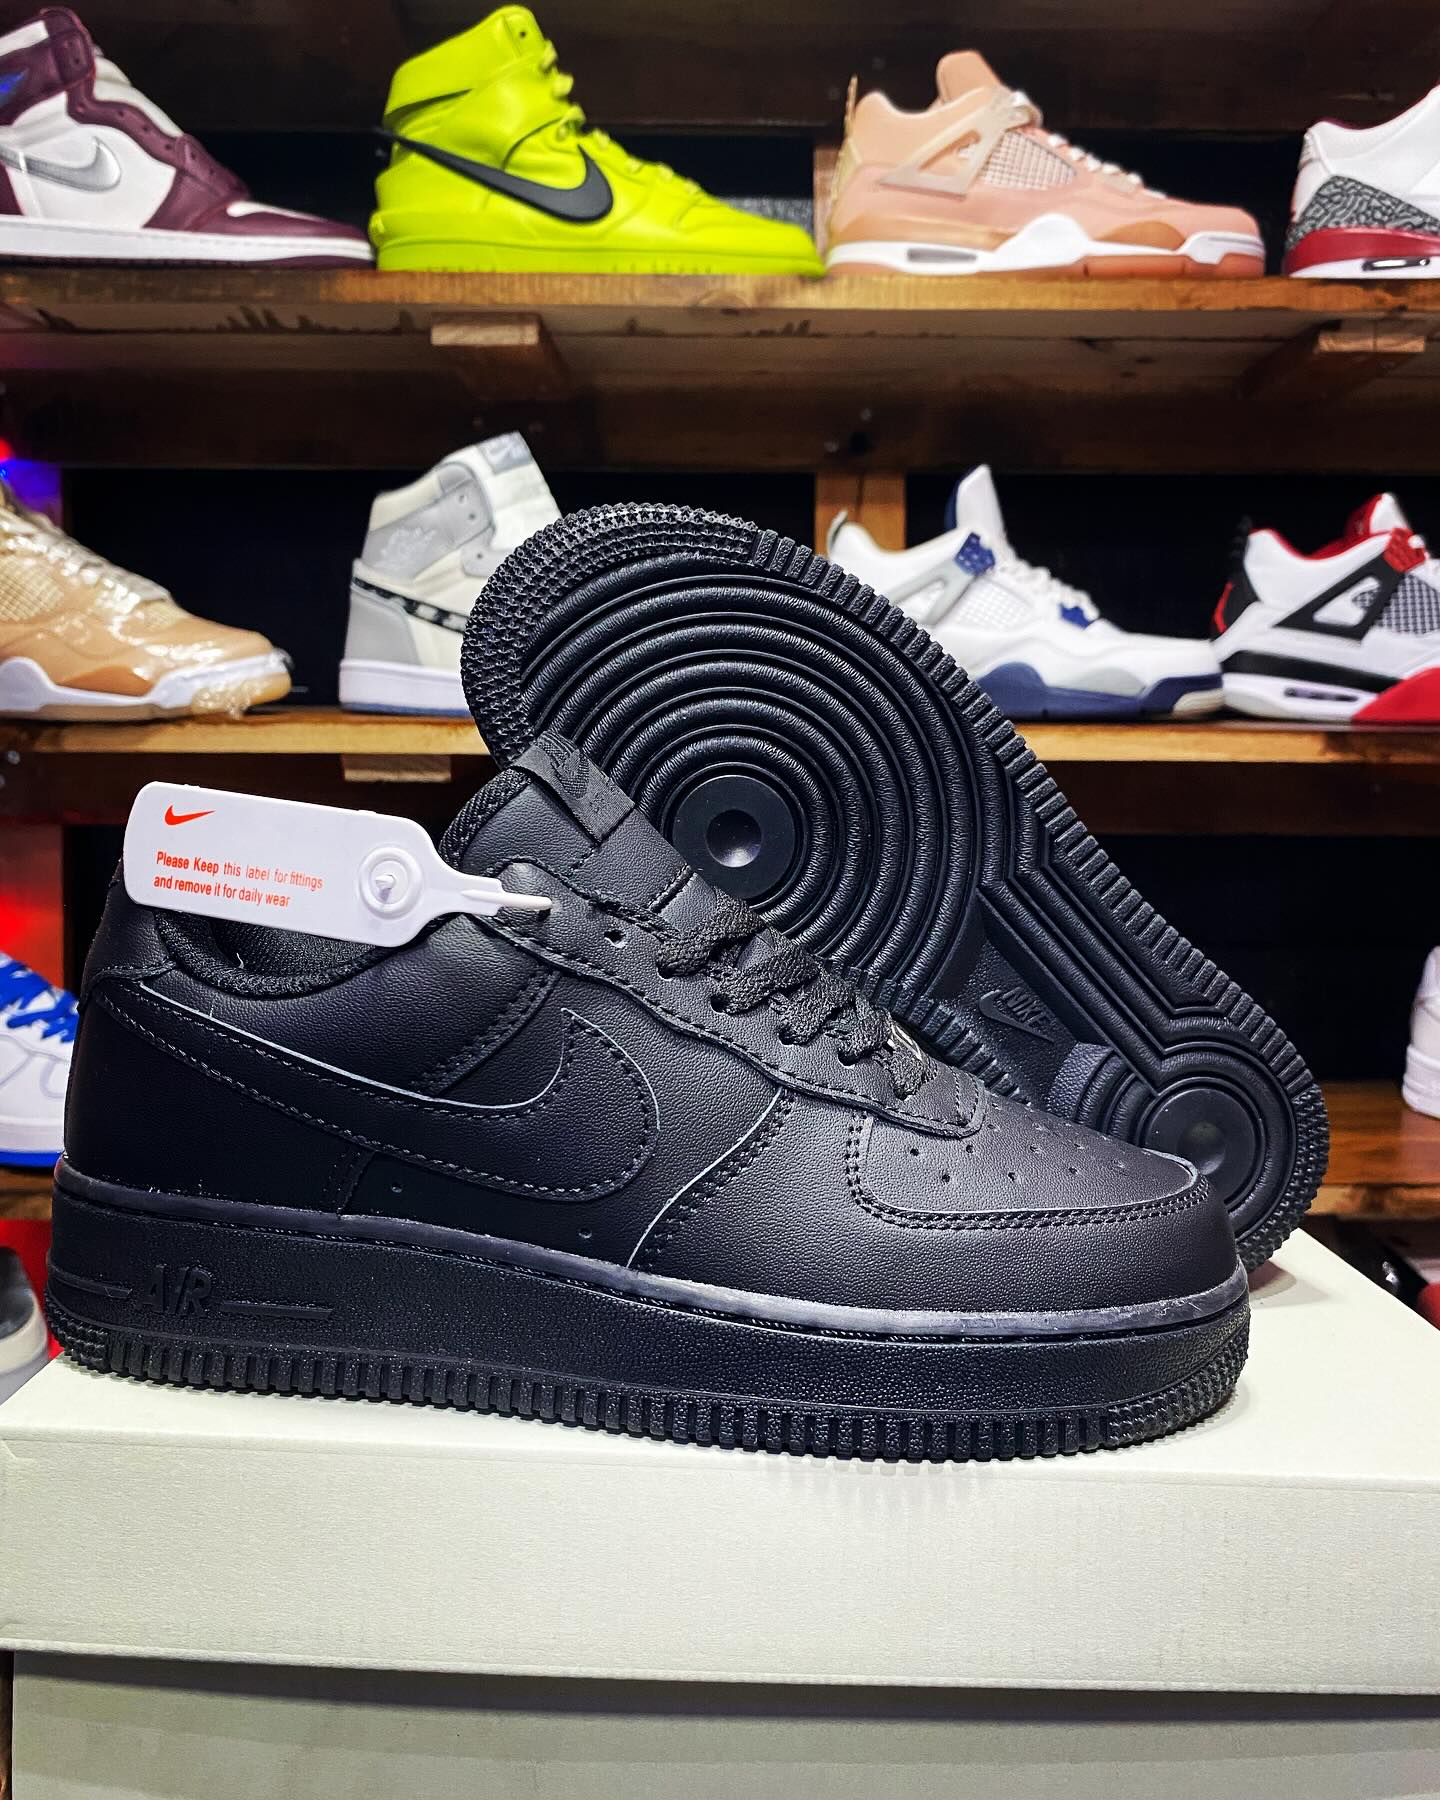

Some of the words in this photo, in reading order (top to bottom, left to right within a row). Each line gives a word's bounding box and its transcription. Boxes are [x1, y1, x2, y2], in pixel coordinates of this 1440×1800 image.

[153, 875, 173, 890] and
[174, 879, 212, 896] remove
[213, 882, 221, 897] it
[222, 883, 237, 899] for
[238, 887, 263, 906] daily
[265, 893, 291, 907] wear
[156, 851, 189, 869] Please
[193, 857, 219, 876] Keep
[223, 862, 241, 877] this
[245, 864, 270, 880] label
[274, 868, 288, 883] for
[289, 871, 324, 892] fittings
[1001, 986, 1057, 1030] NIKE
[136, 1263, 212, 1318] AIR
